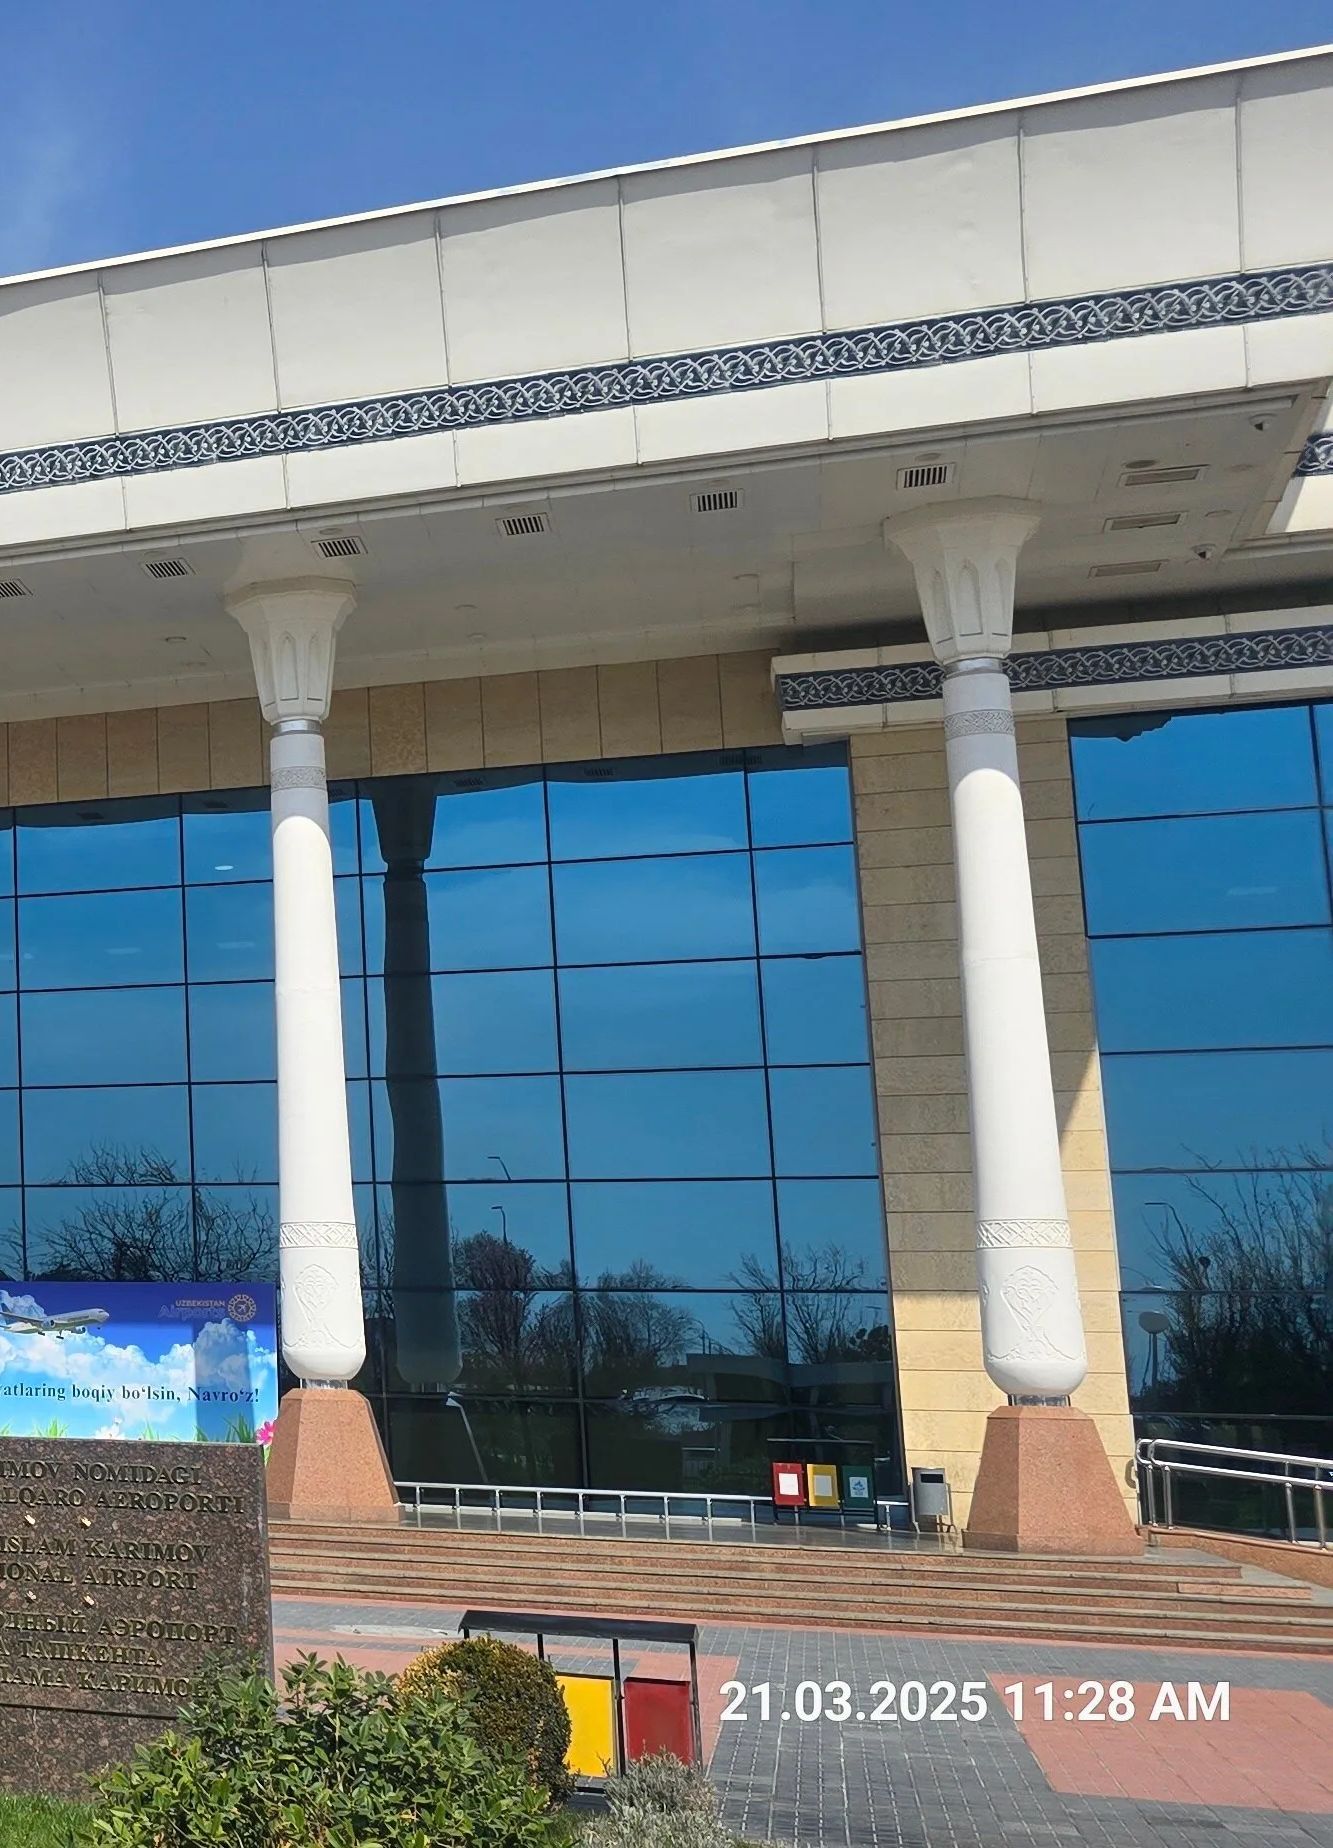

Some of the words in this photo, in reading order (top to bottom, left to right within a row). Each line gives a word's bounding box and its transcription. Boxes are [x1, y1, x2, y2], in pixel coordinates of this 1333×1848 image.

[72, 1384, 115, 1402] boqiy
[73, 1461, 202, 1485] NOMIDAGI
[94, 1489, 244, 1514] AEROPORTI
[85, 1538, 210, 1563] KARIMOV
[83, 1565, 199, 1591] AIRPORT
[97, 1617, 237, 1645] АЭРОПОРТ
[17, 1637, 163, 1667] ТАШКЕНТА
